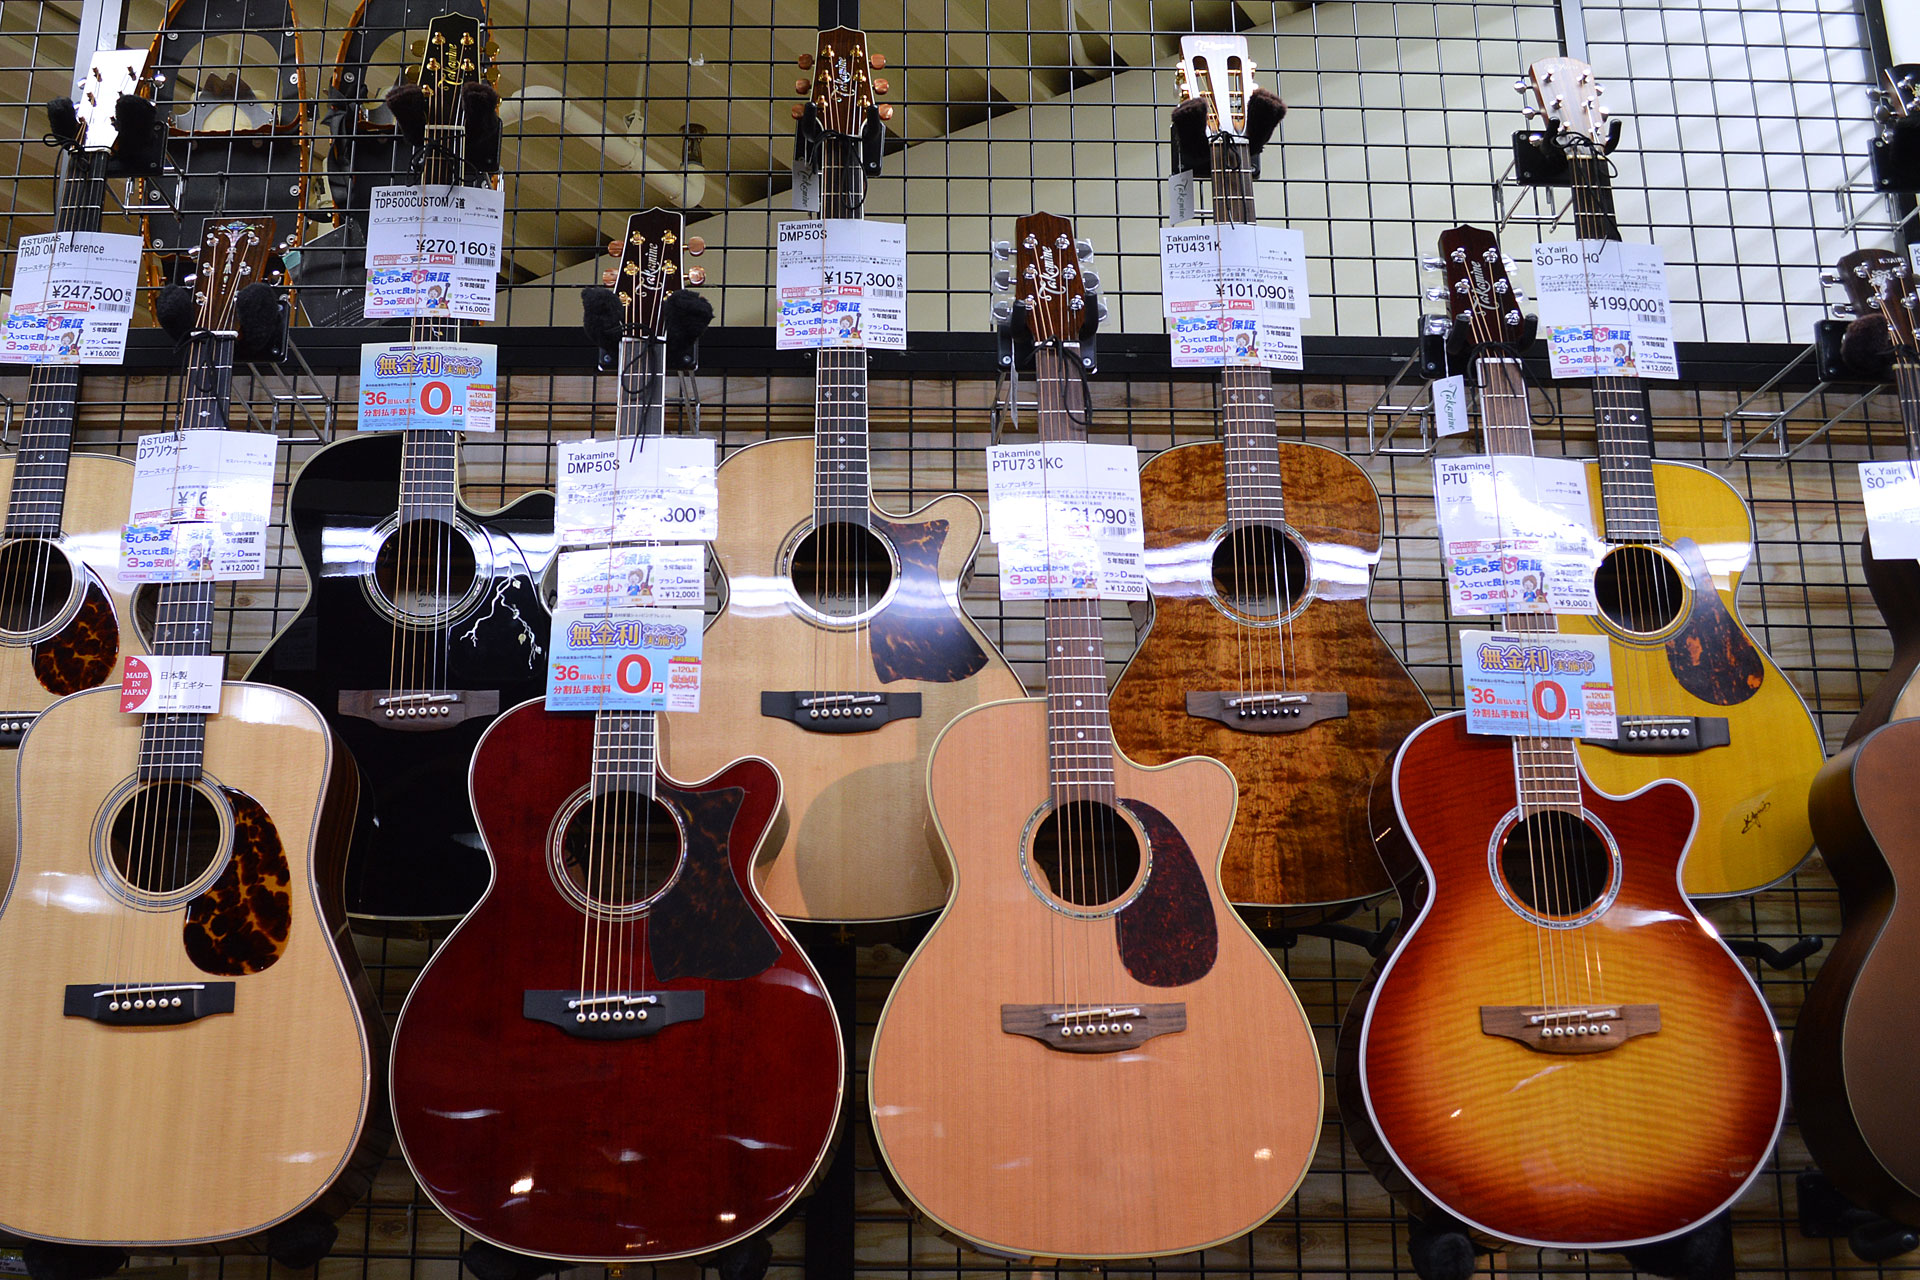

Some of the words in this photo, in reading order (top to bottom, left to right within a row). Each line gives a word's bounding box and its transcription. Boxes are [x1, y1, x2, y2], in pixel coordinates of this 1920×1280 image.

[376, 189, 418, 197] Takamine
[780, 222, 822, 230] Takamine
[21, 235, 61, 246] ASTURIAS
[780, 229, 827, 242] DMP50S
[20, 244, 40, 258] TRAD
[58, 243, 104, 254] Reverence
[416, 239, 488, 256] ¥270,160
[1167, 241, 1222, 254] PTU431K
[1537, 253, 1578, 266] SO-RO
[372, 270, 451, 285] もしもの安心保証
[635, 243, 663, 297] Takamine
[1038, 245, 1067, 301] Takamine
[824, 271, 895, 288] ¥157,300
[52, 285, 123, 302] ¥247,500
[1216, 284, 1286, 300] ¥101,090
[1470, 260, 1499, 316] Takamine
[782, 299, 861, 316] もしもの安心保証
[1589, 297, 1657, 313] ¥199,000
[6, 315, 84, 331] もしもの安心保証
[1175, 317, 1256, 333] もしもの安心保証
[1553, 327, 1630, 343] もしもの安心保証
[377, 353, 439, 376] 無金利
[364, 408, 416, 417] 分割払手数料
[1440, 383, 1457, 431] Takamine
[140, 434, 186, 446] ASTURIAS
[139, 445, 188, 460] Dプリウォー
[568, 451, 615, 461] Takamine
[992, 449, 1041, 458] Takamine
[568, 459, 620, 474] DMP50S
[992, 457, 1064, 471] PTU731KC
[1441, 463, 1490, 472] Takamine
[1864, 468, 1875, 476] K.
[1878, 467, 1901, 475] Yairi
[1454, 556, 1543, 576] もしもの安心保証
[570, 622, 638, 646] 無金利
[1481, 647, 1548, 673] 無金利
[161, 671, 187, 680] 日本製
[173, 682, 213, 690] 手工ギター
[553, 685, 611, 694] 分割払手数料
[1472, 709, 1529, 719] 分割払手数料
